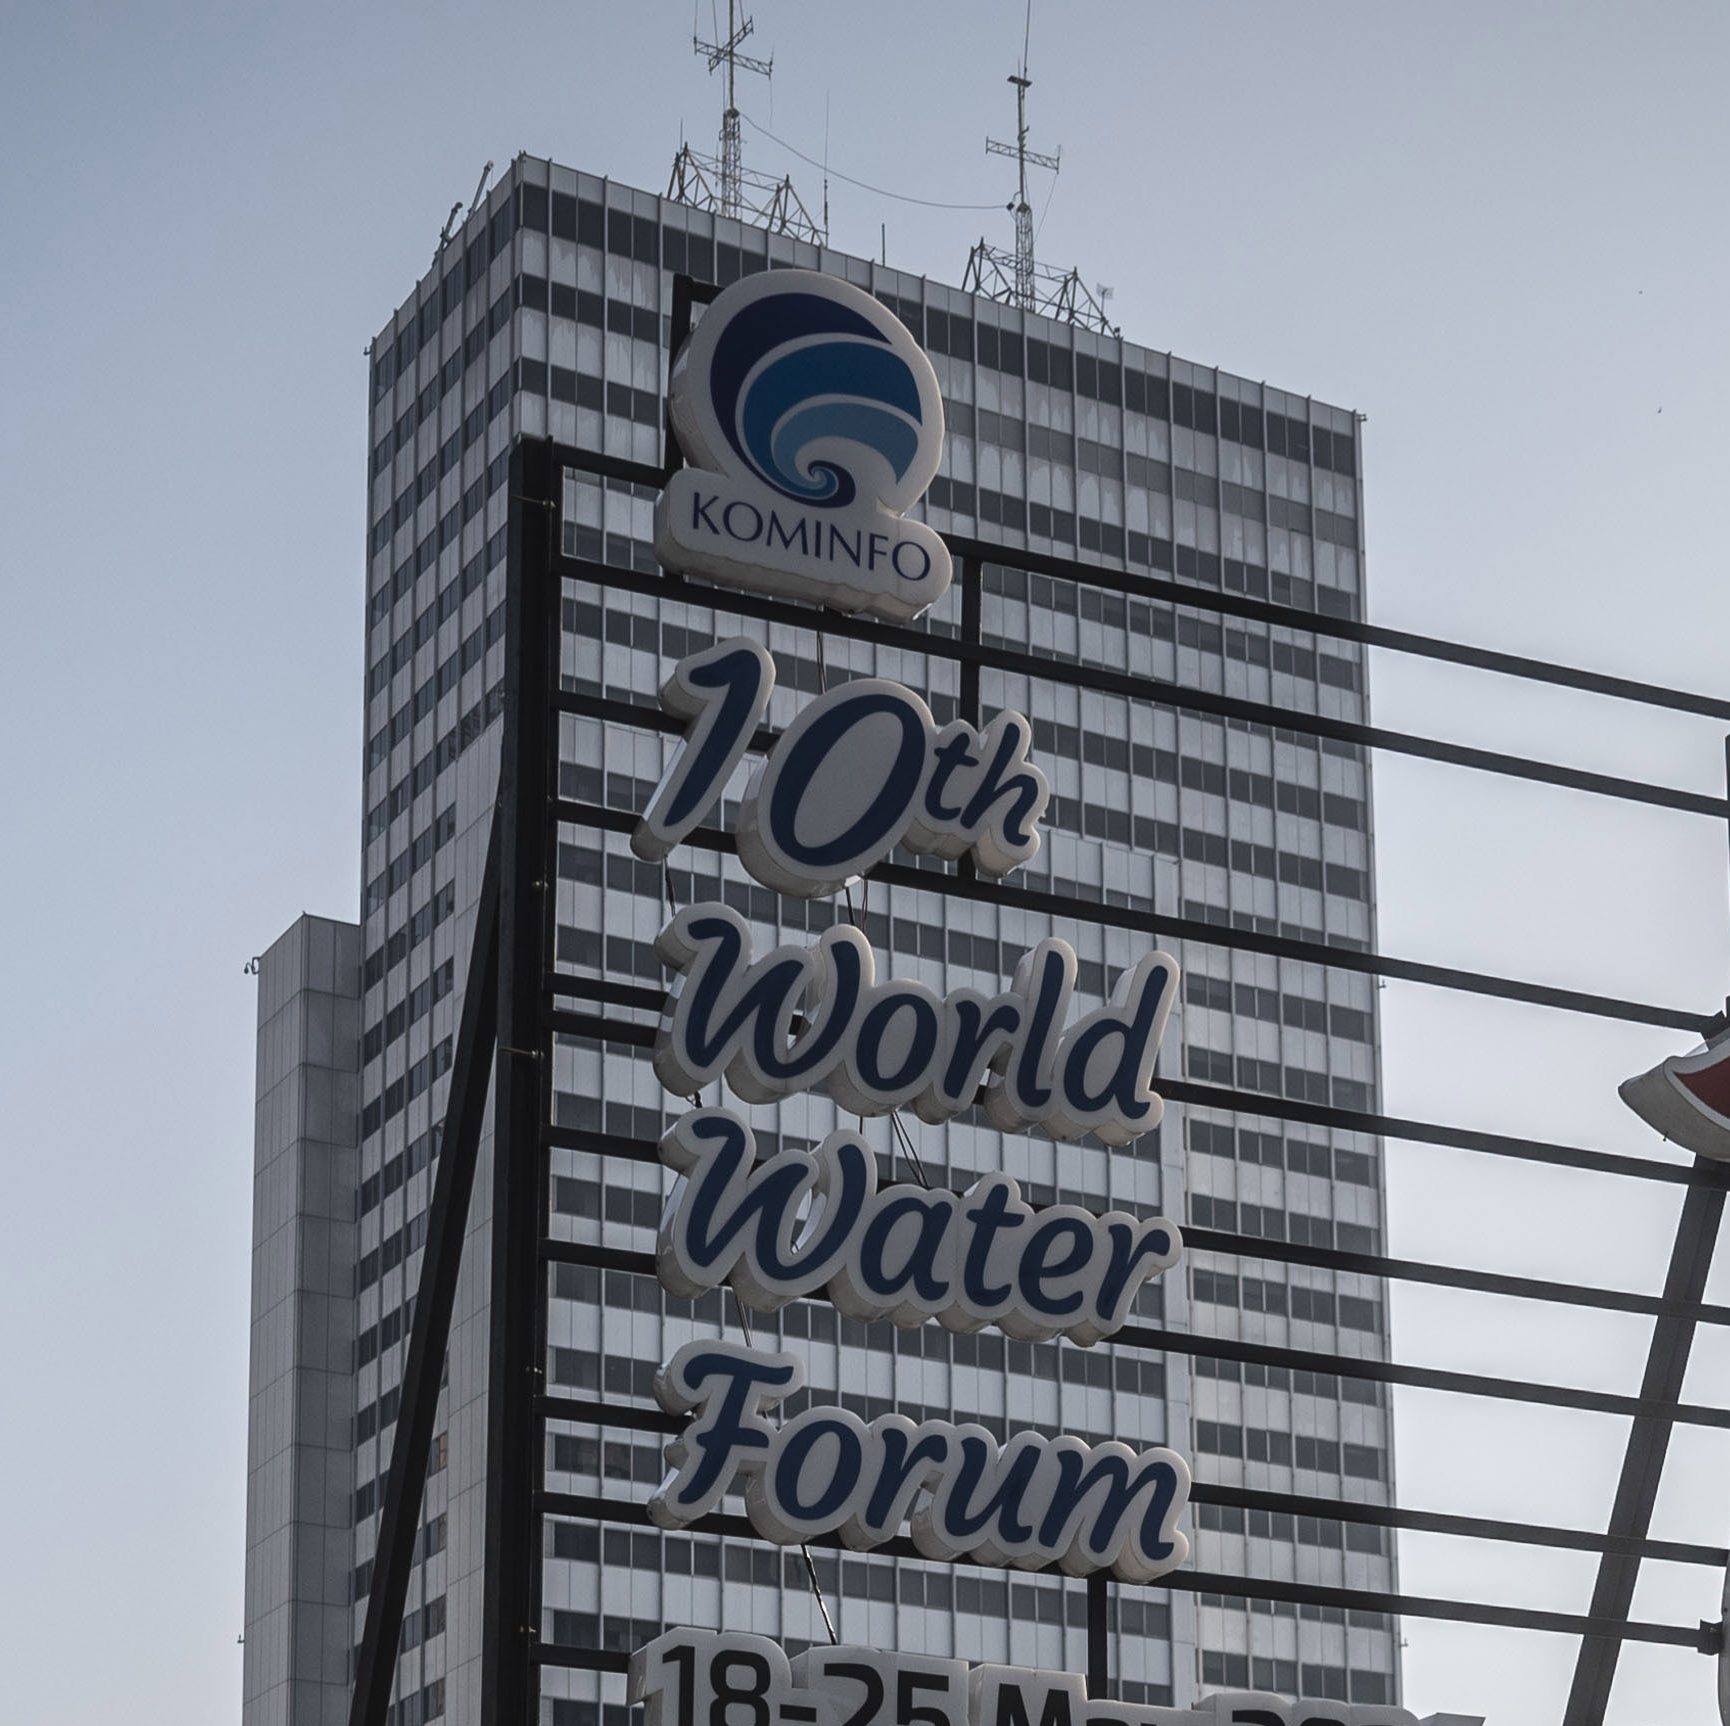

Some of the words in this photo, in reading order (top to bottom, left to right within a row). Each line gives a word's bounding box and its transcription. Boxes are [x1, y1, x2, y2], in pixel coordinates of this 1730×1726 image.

[689, 491, 932, 581] KOMINFO
[660, 646, 1043, 867] 10th
[685, 916, 1170, 1121] World
[684, 1116, 1171, 1322] Water
[679, 1351, 1186, 1563] Forum
